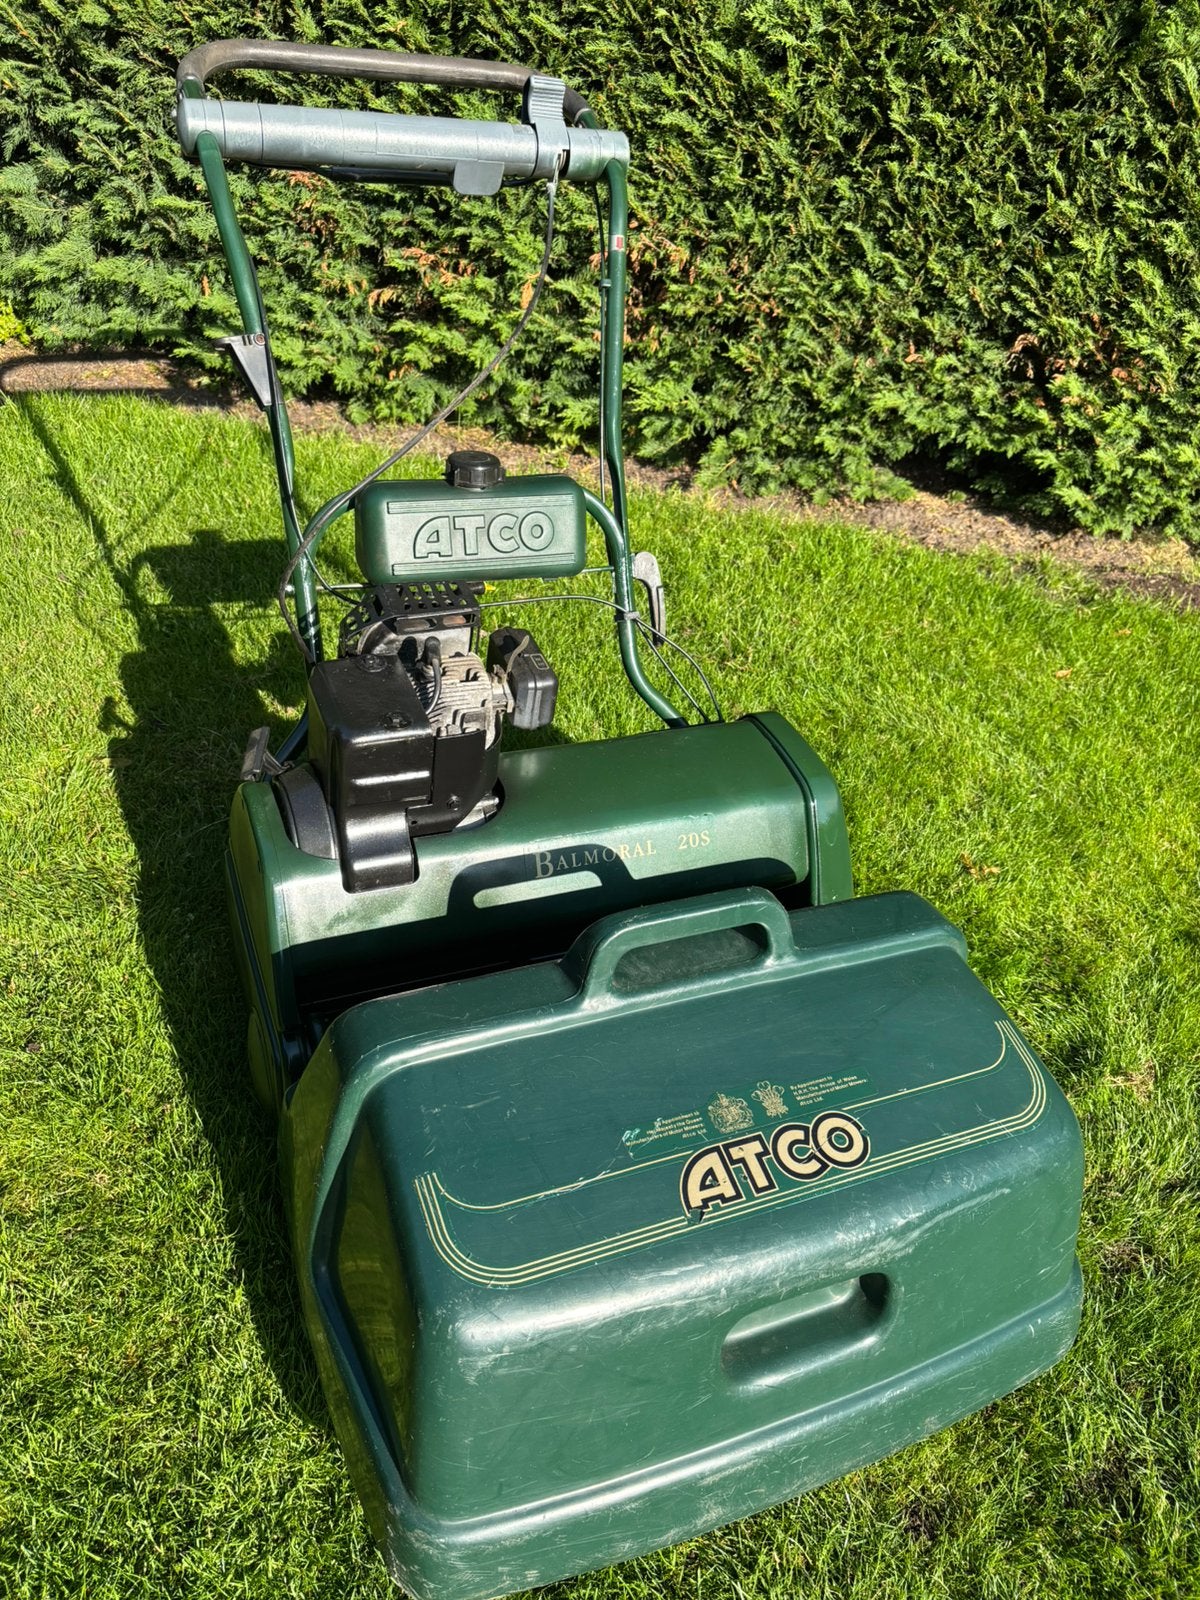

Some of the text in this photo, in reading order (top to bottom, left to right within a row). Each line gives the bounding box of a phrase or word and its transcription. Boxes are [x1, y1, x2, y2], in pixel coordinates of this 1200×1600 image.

[413, 511, 554, 559] ATCO
[534, 830, 711, 879] BALMORAL 20S
[797, 1077, 827, 1088] Appointment
[819, 1081, 836, 1089] Prince
[796, 1089, 830, 1101] Manufacturers
[834, 1083, 849, 1091] Motor
[661, 1112, 694, 1125] Appointment
[685, 1116, 703, 1125] Queen
[668, 1127, 684, 1135] Motor
[680, 1110, 870, 1217] ATCO
